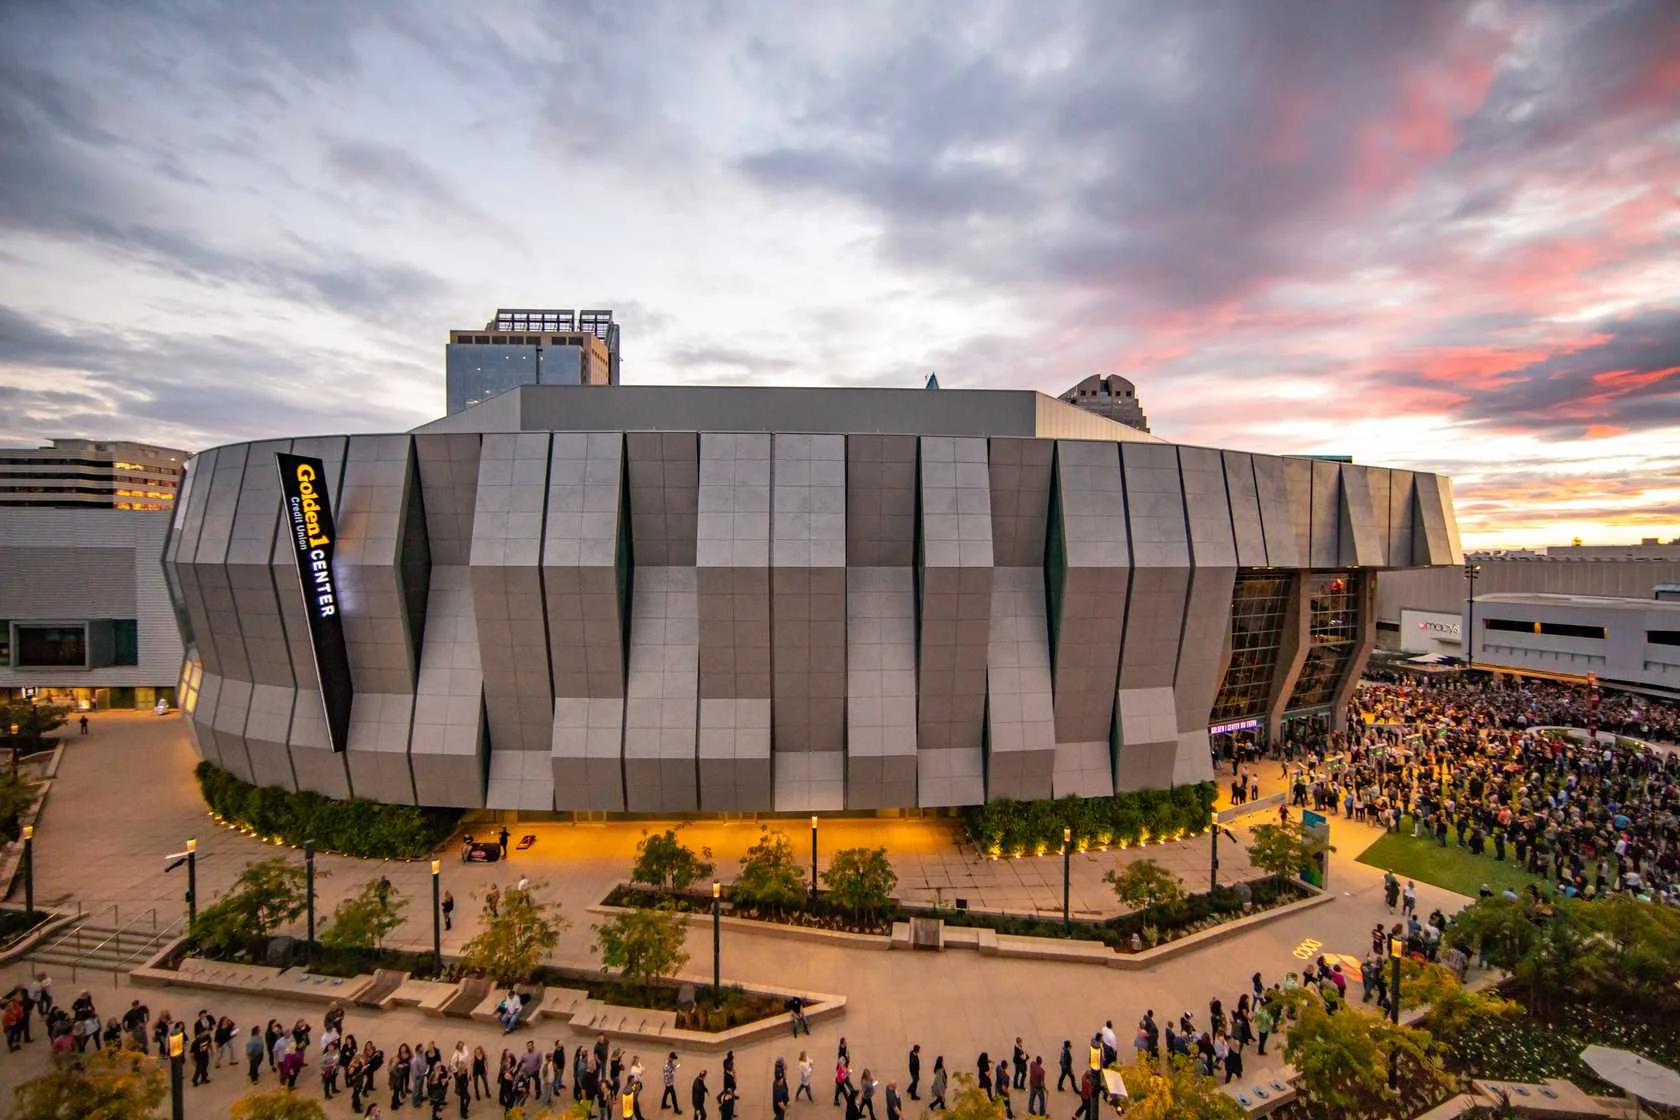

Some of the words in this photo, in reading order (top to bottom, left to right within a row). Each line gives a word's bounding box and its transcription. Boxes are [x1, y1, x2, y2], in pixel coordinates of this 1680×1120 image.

[291, 496, 303, 523] Credit
[296, 525, 307, 550] Union
[297, 463, 321, 536] Golden
[311, 549, 336, 618] CENTER
